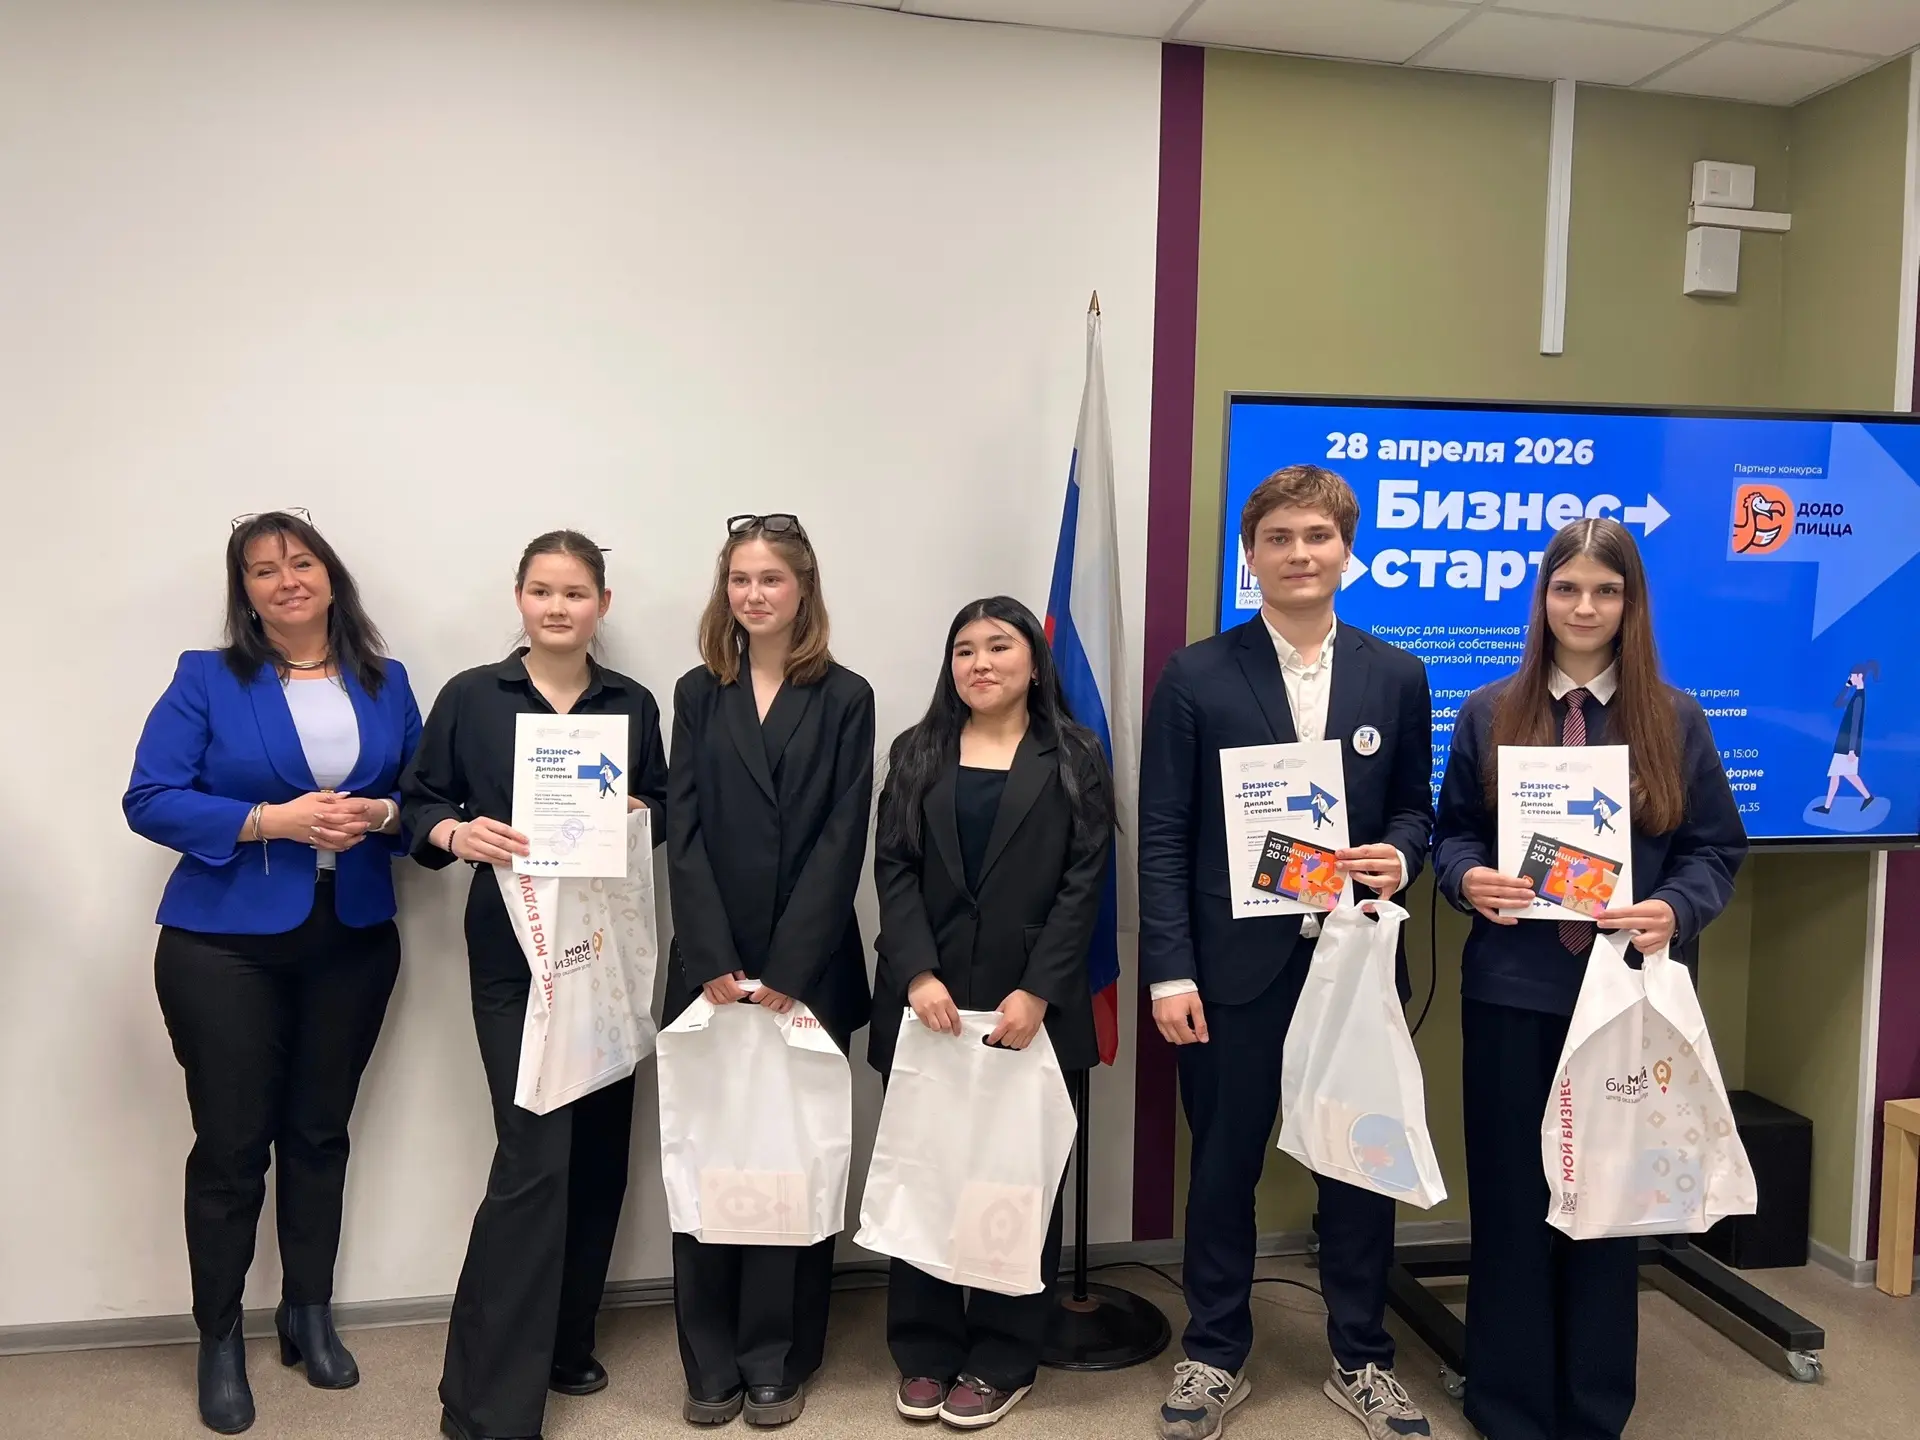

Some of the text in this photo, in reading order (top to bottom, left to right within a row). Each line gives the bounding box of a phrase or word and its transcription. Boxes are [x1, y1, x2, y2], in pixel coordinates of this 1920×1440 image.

[1326, 432, 1595, 467] 28 апреля 2026
[1734, 464, 1823, 475] Партнер конкурса
[1376, 479, 1623, 532] Бизнес
[1797, 503, 1844, 518] ДОДО
[1795, 522, 1852, 537] ПИЦЦА
[1371, 624, 1530, 637] Конкурс для школьников 7
[1418, 654, 1472, 666] пертизой
[1700, 689, 1740, 699] апреля
[536, 747, 574, 756] Бизнес
[1723, 748, 1759, 758] в 15:00
[535, 756, 565, 764] старт
[535, 765, 566, 773] Диплом
[1725, 767, 1764, 780] форме
[1242, 780, 1280, 791] Бизнес
[1520, 781, 1561, 790] Бизнес
[1242, 790, 1272, 799] старт
[1520, 790, 1552, 799] старт
[1244, 800, 1275, 809] Диплом
[1250, 807, 1282, 815] степени
[1266, 849, 1294, 864] 20 см
[1269, 840, 1282, 850] на
[1282, 843, 1313, 861] пиццу
[1548, 847, 1581, 866] пиццу
[1530, 852, 1559, 867] 20 см
[531, 923, 549, 957] МОЕ
[554, 949, 592, 970] изнес
[1560, 1078, 1573, 1139] БИЗНЕС
[1560, 1143, 1575, 1182] МОЙ
